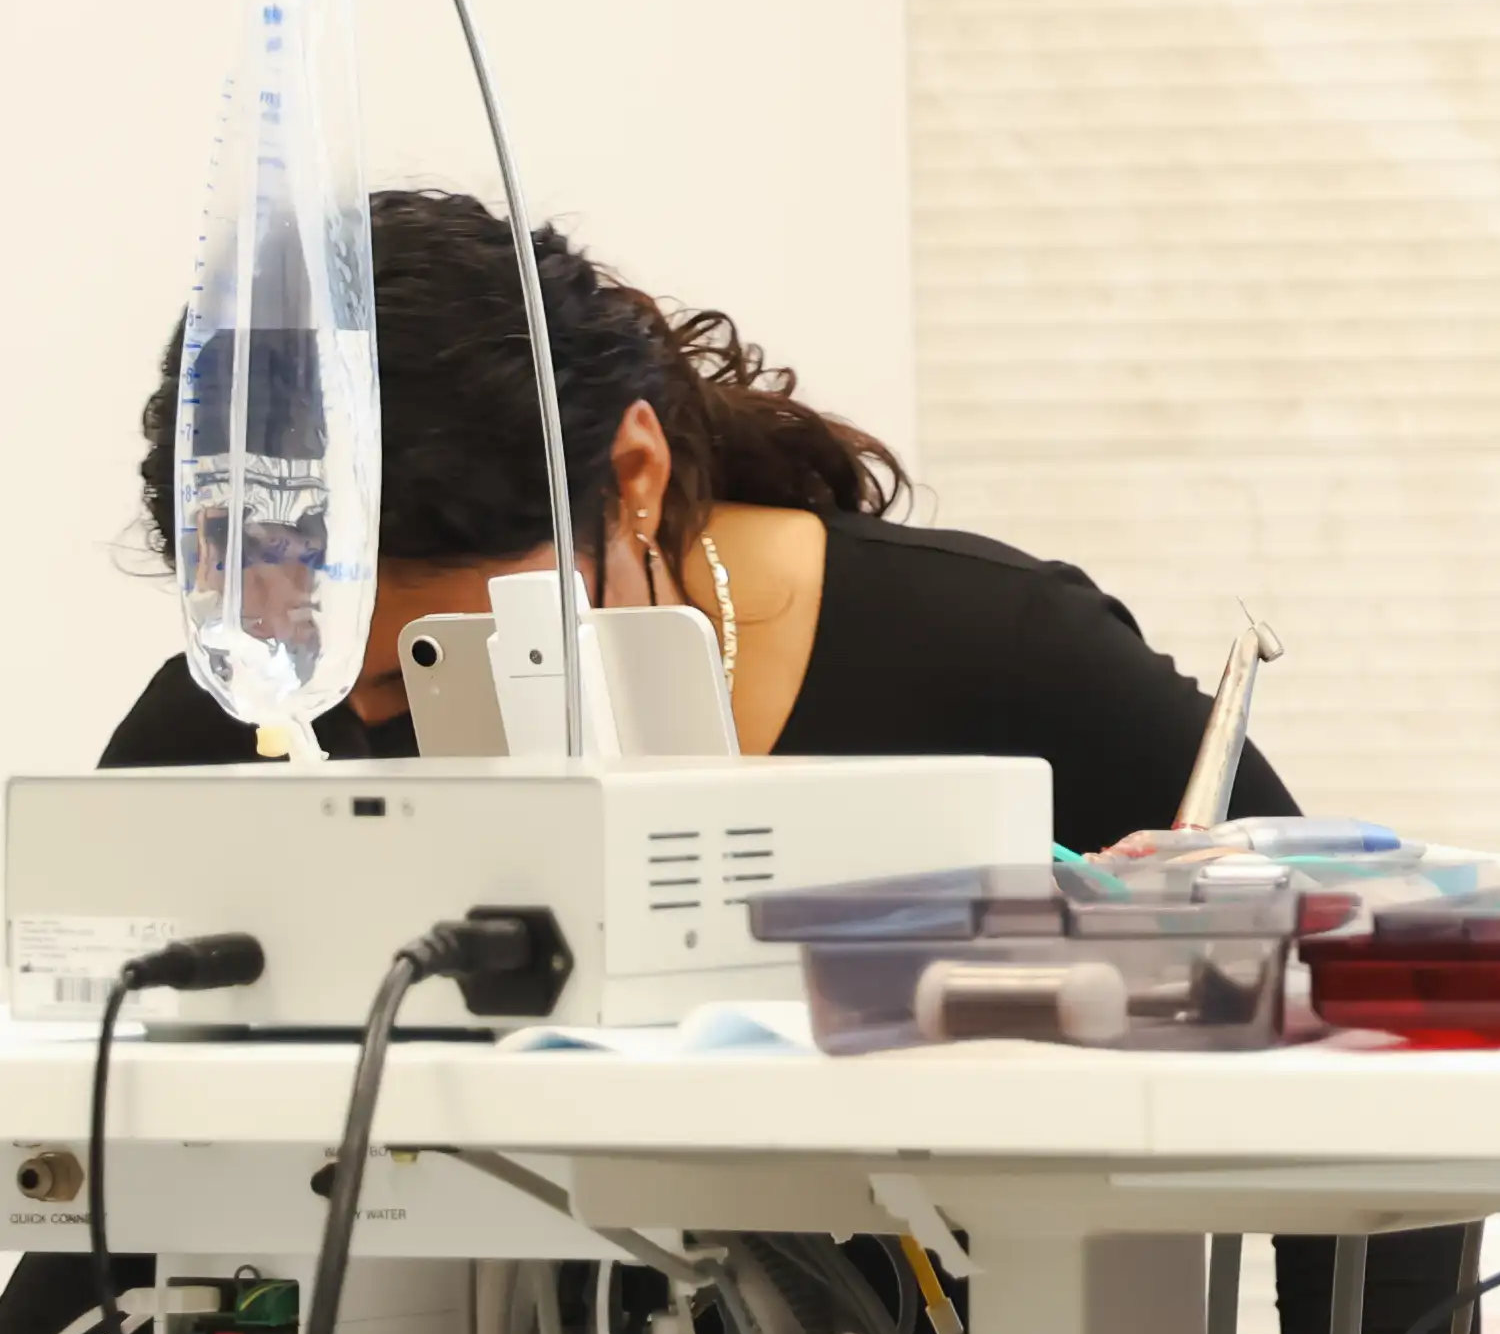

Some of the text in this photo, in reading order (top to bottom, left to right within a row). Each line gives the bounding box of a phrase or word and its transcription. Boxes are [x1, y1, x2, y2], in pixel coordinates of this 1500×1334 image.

[10, 1213, 106, 1225] QUICK CONNE
[366, 1208, 407, 1220] WATER
